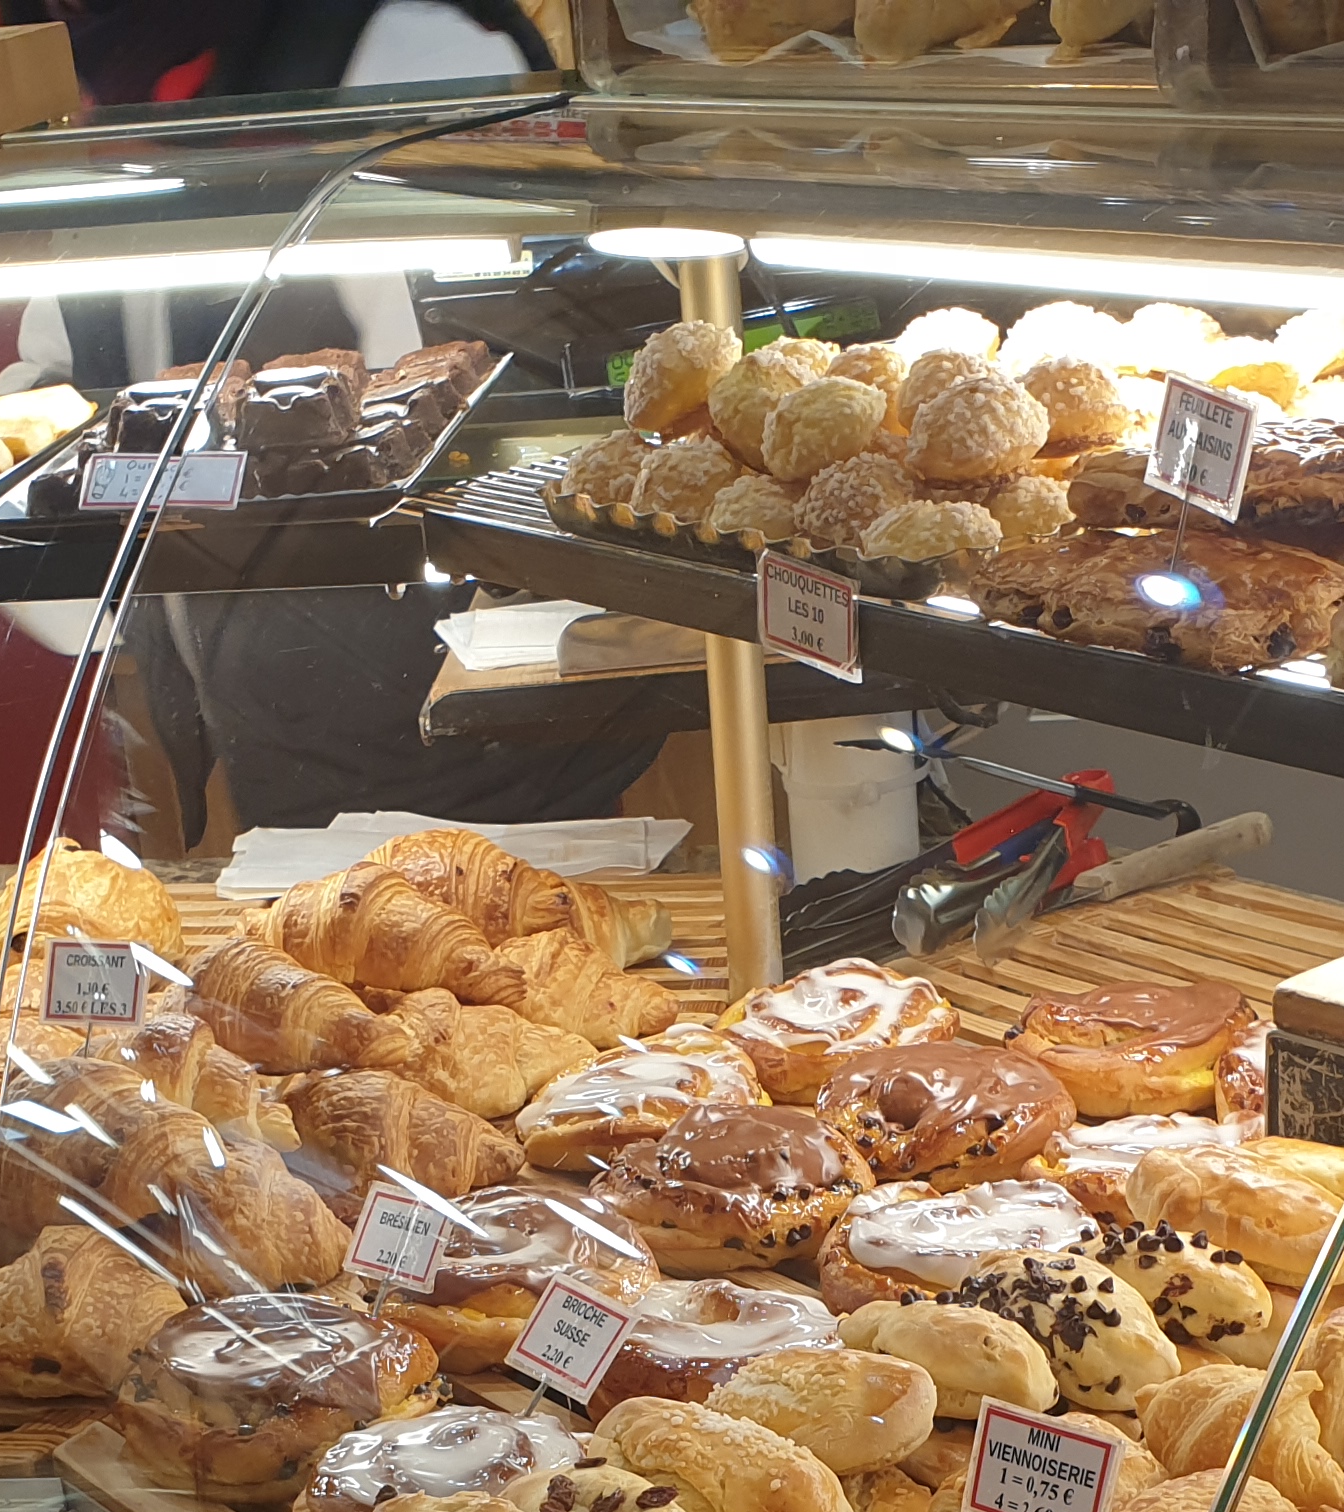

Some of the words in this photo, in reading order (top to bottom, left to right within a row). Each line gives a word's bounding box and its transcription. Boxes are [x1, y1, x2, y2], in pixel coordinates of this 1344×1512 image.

[1189, 424, 1233, 461] AISINS
[767, 563, 849, 607] CHOUQUETTES
[788, 597, 809, 618] LES
[812, 606, 824, 624] 10
[792, 626, 813, 648] 3,00
[817, 637, 825, 652] €
[66, 954, 127, 968] CROISSANT
[55, 1000, 79, 1014] 3,50
[91, 1001, 117, 1015] LES
[119, 1002, 127, 1016] 3
[562, 1296, 608, 1328] BRIOCHE
[554, 1319, 591, 1347] SUISSE
[563, 1356, 573, 1369] €
[1028, 1428, 1061, 1452] MINI
[989, 1439, 1096, 1489] VIENNOISERIE
[1000, 1467, 1007, 1484] 1
[1012, 1475, 1023, 1484] =
[1026, 1476, 1059, 1500] 0,75
[1063, 1488, 1075, 1505] €
[995, 1493, 1004, 1509] 4
[1007, 1501, 1018, 1510] =
